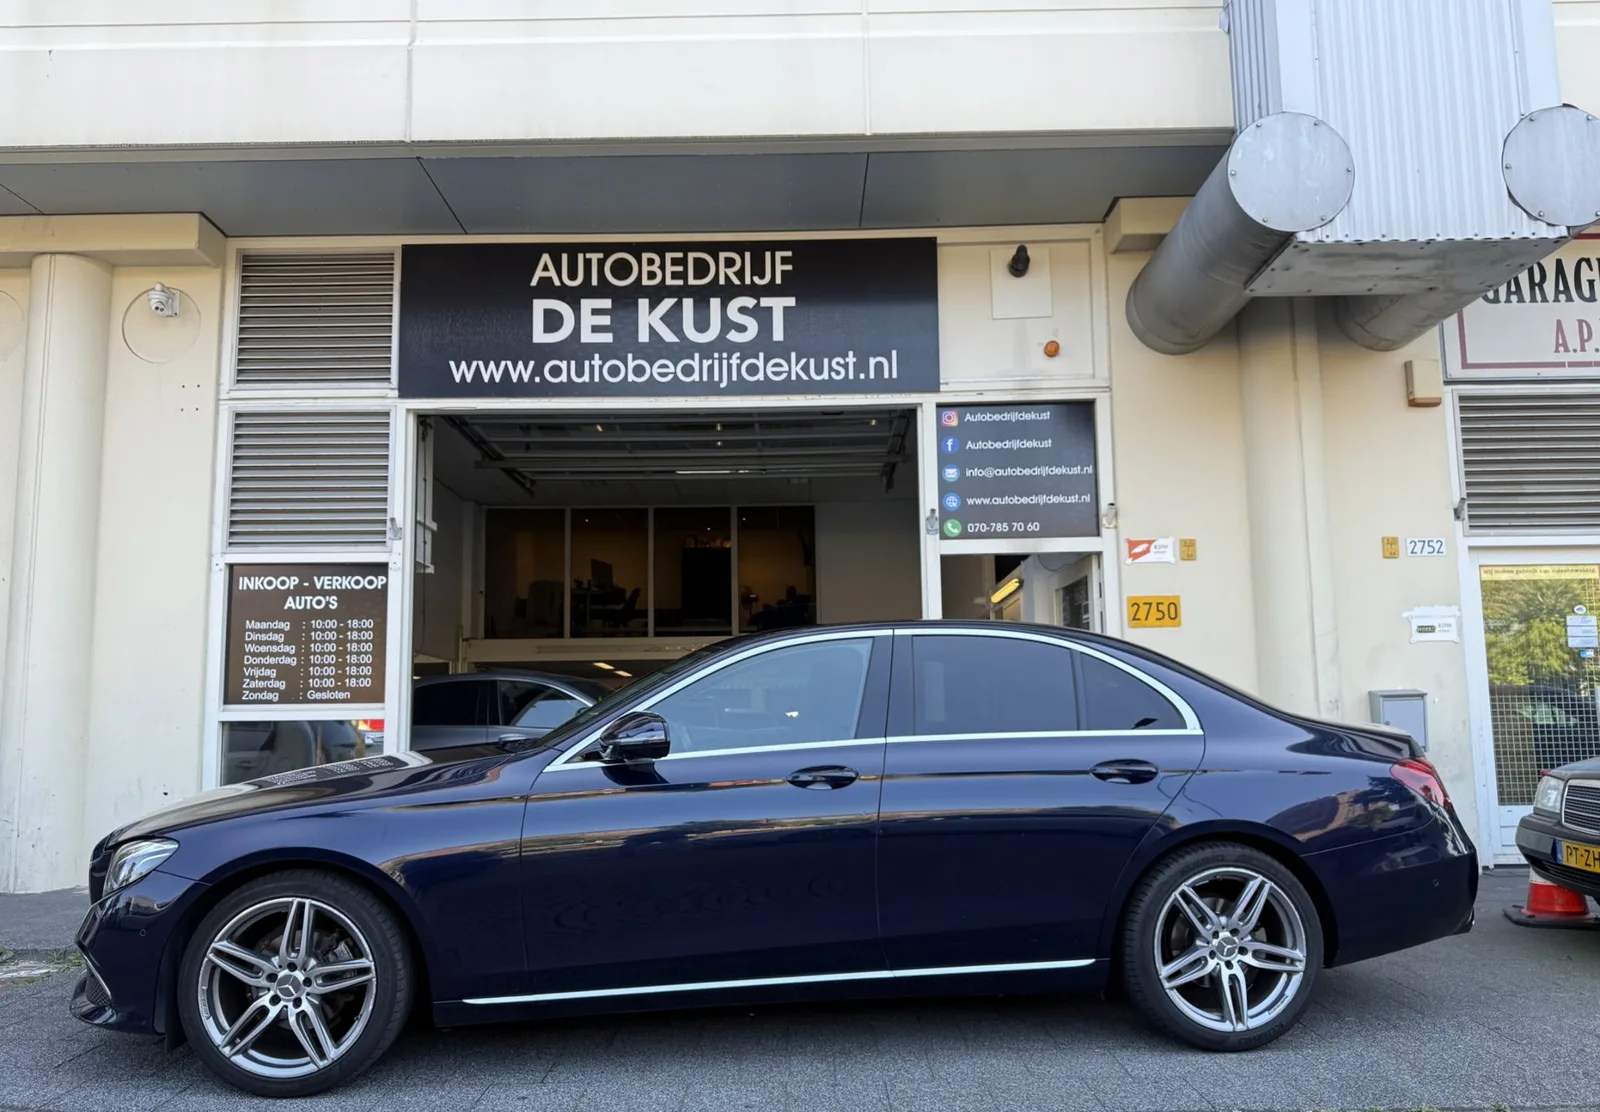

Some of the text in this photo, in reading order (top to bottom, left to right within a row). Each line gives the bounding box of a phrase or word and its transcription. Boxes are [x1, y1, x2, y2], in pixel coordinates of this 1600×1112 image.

[529, 250, 793, 287] AUTOBEDRIJF
[1481, 257, 1600, 304] ARAG
[532, 296, 796, 344] DE KUST
[448, 349, 898, 389] www.autobedrijfdekust.nl
[964, 411, 1051, 423] Autobedrijfdekust
[965, 438, 1052, 450] Autobedrijfdekust
[965, 464, 1093, 478] info@autobedrijfdekust.nl
[966, 493, 1091, 507] www.autobedrijfdekust.nl
[967, 521, 1040, 533] 070-785 70 60
[1409, 539, 1444, 555] 2752
[238, 576, 300, 591] INKOOP
[313, 575, 387, 590] VERKOOP
[283, 595, 338, 610] AUTO'S
[1131, 601, 1178, 622] 2750
[245, 620, 290, 631] Maandag
[310, 620, 338, 629] 10:00
[347, 619, 374, 629] 18:00
[245, 631, 285, 642] Dinsdag
[310, 631, 337, 640] 10:00
[346, 631, 374, 640] 18:00
[244, 643, 296, 654] Woensdag
[309, 643, 337, 652] 10:00
[346, 643, 373, 652] 18:00
[244, 655, 297, 666] Donderdag
[309, 655, 336, 664] 10:00
[345, 655, 373, 664] 18:00
[243, 667, 277, 678] Vrijdag
[308, 666, 336, 676] 10:00
[345, 666, 372, 675] 18:00
[242, 678, 286, 689] Zaterdag
[308, 678, 335, 688] 10:00
[344, 678, 372, 687] 18:00
[242, 690, 279, 701] Zondag
[306, 690, 351, 700] Gesloten
